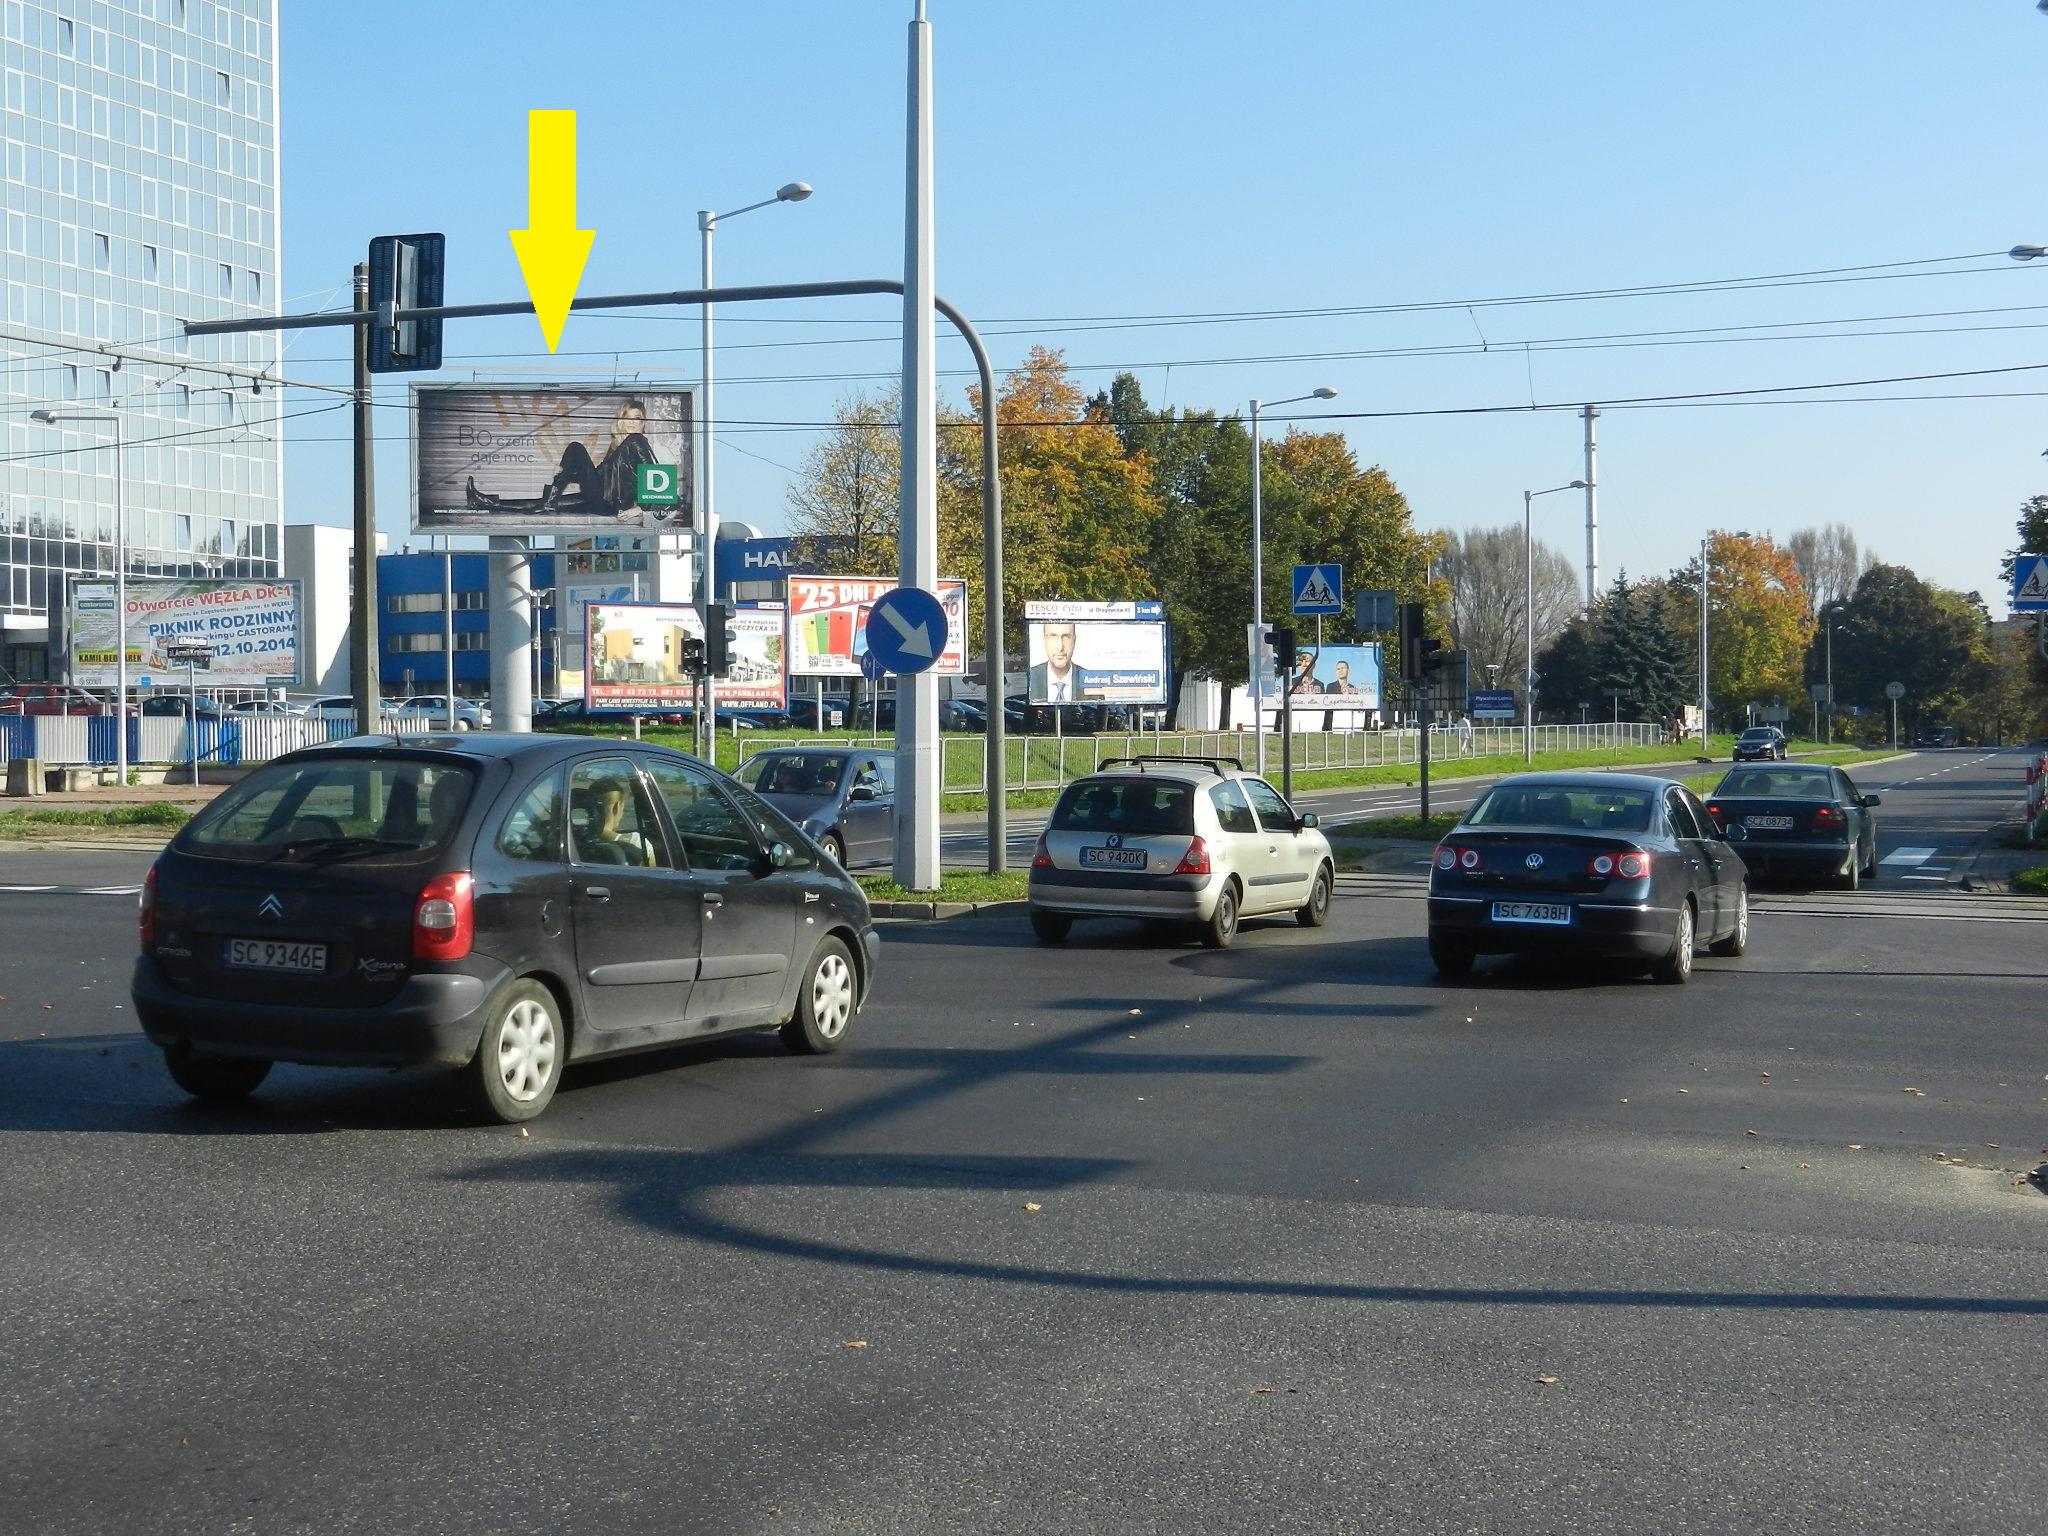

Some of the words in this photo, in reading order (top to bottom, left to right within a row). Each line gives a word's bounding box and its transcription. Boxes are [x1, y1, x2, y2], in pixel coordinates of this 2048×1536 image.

[471, 451, 500, 464] daje
[504, 452, 538, 464] moc.
[646, 469, 670, 493] D
[126, 596, 195, 613] Otwarcie
[199, 589, 252, 606] WĘZŁA
[256, 585, 291, 600] DK-1
[798, 582, 836, 610] 25
[839, 584, 869, 602] DNI
[79, 601, 113, 609] castorama
[1030, 604, 1058, 615] TESCO
[149, 619, 206, 637] PIKNIK
[210, 609, 296, 630] RODZINNY
[237, 624, 297, 637] CASTORAMA
[213, 637, 296, 657] 12.10.2014
[79, 653, 101, 663] KAMIL
[103, 653, 142, 663] BEDAREK
[1083, 675, 1111, 686] Andrzej
[721, 700, 778, 708] WWW.OFFLAND.PL
[1747, 816, 1763, 826] SCZ
[1766, 816, 1793, 827] 08734
[1088, 850, 1103, 862] SC
[1108, 851, 1141, 864] 9420K
[1501, 904, 1520, 918] SC
[1523, 905, 1568, 921] 7638H
[231, 941, 258, 965] SC
[264, 942, 326, 970] 9346E
